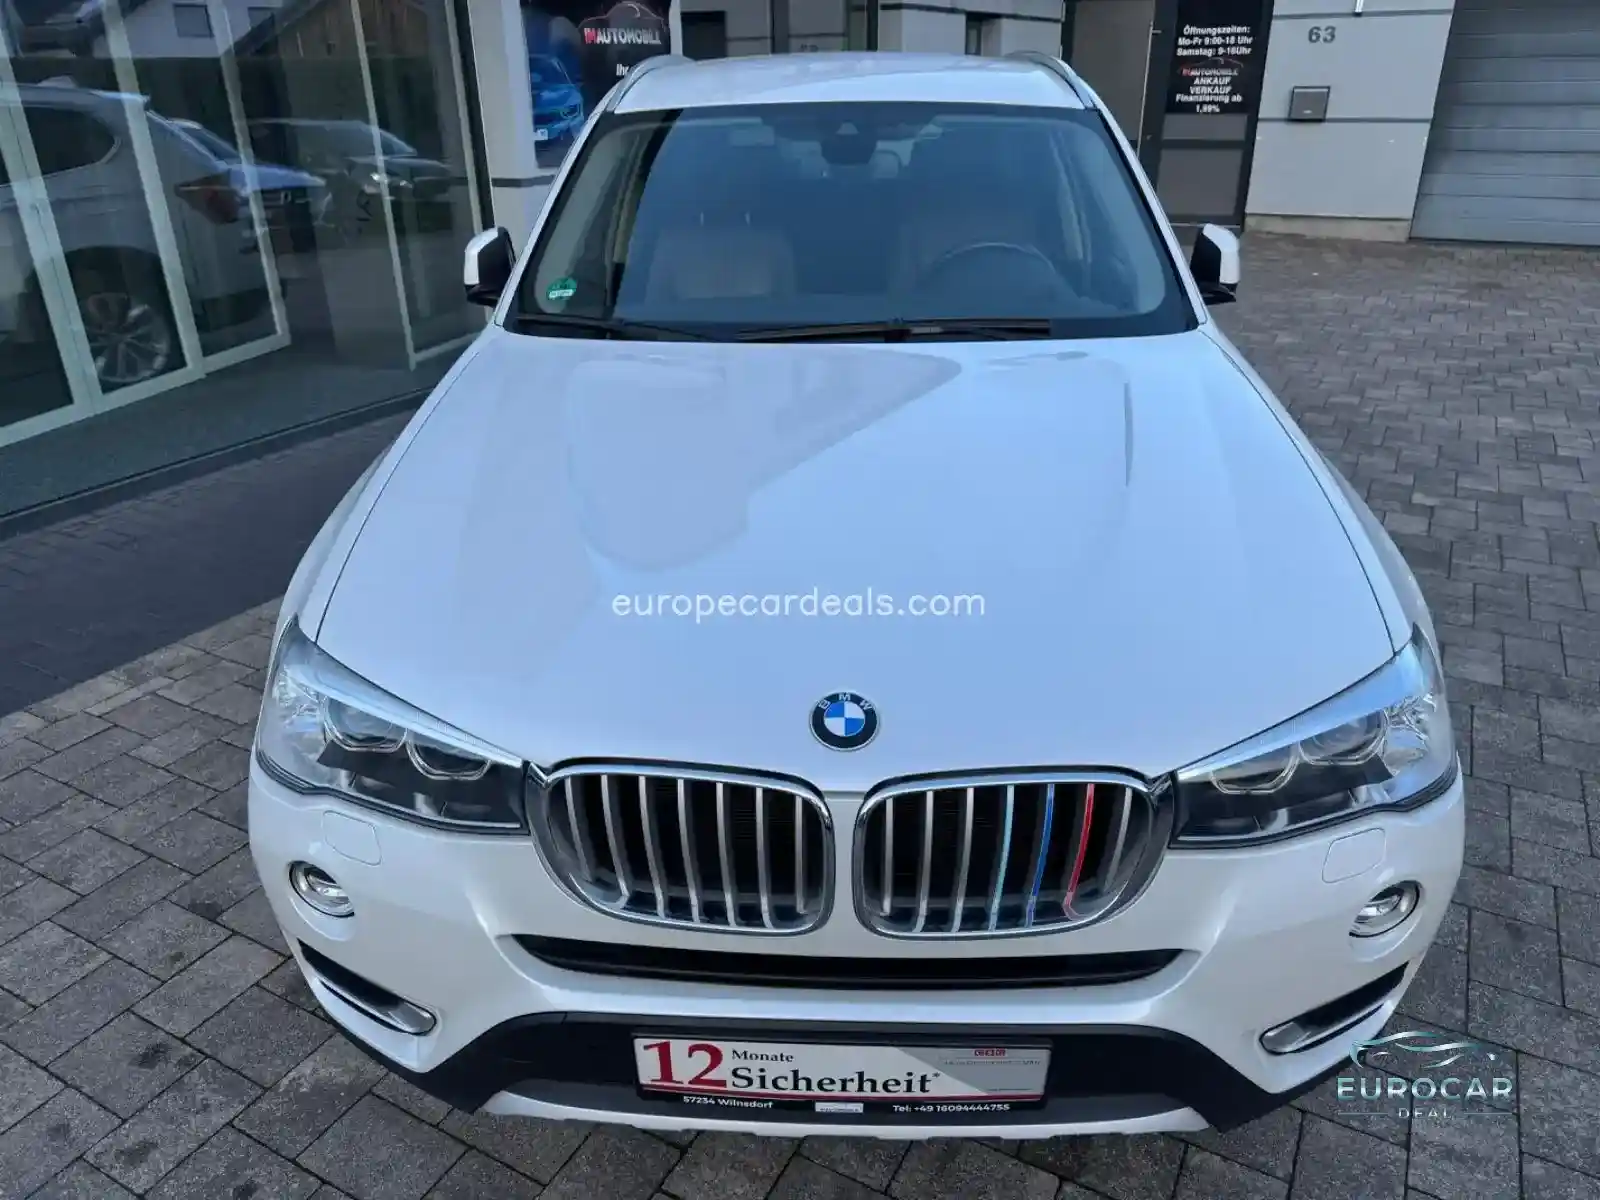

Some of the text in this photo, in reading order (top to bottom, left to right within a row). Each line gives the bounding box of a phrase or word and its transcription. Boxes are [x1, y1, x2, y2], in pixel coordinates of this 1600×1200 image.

[1308, 26, 1336, 43] 63
[1178, 36, 1202, 46] Mo-Fr
[1237, 35, 1253, 45] Uhr
[1176, 47, 1216, 57] Samstag:
[1193, 76, 1232, 85] ANKAUF
[1189, 86, 1232, 95] VERKAUF
[1175, 93, 1243, 104] Finanzierung ab
[819, 692, 874, 710] BMW
[732, 1049, 794, 1063] Monate
[643, 1040, 727, 1089] 12
[683, 1095, 774, 1109] 57234 Wilnsdorf
[892, 1104, 912, 1113] Tel:
[914, 1104, 934, 1113] +49
